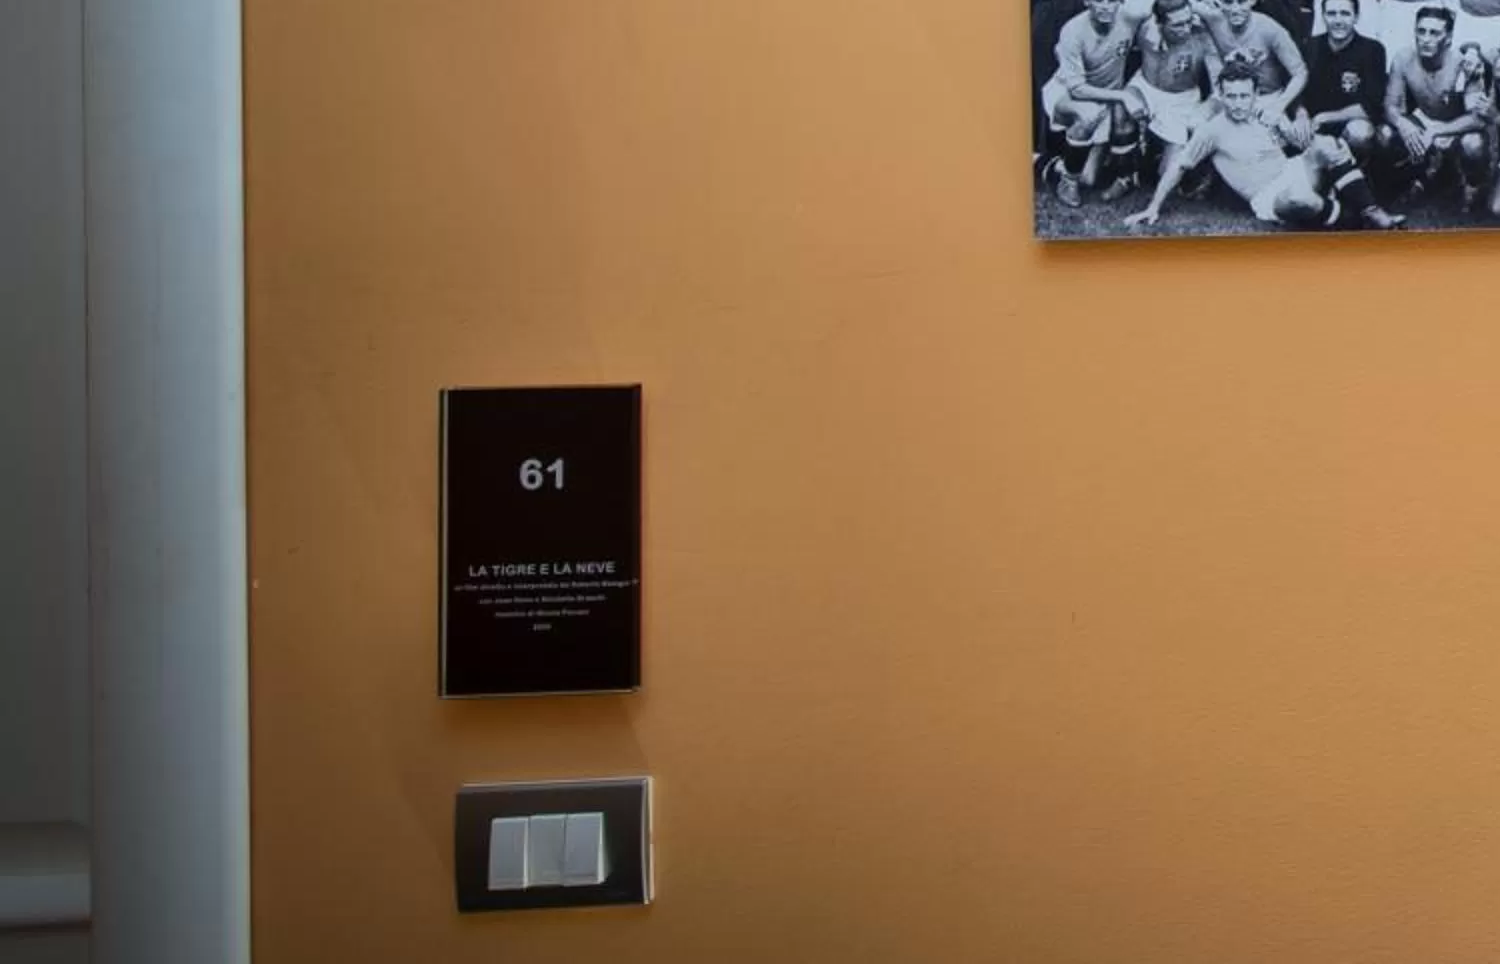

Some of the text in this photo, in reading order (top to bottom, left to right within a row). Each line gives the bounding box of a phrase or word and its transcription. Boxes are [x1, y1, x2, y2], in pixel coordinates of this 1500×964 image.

[519, 457, 564, 490] 61
[468, 560, 616, 577] LA TIGRE E LA NEVE
